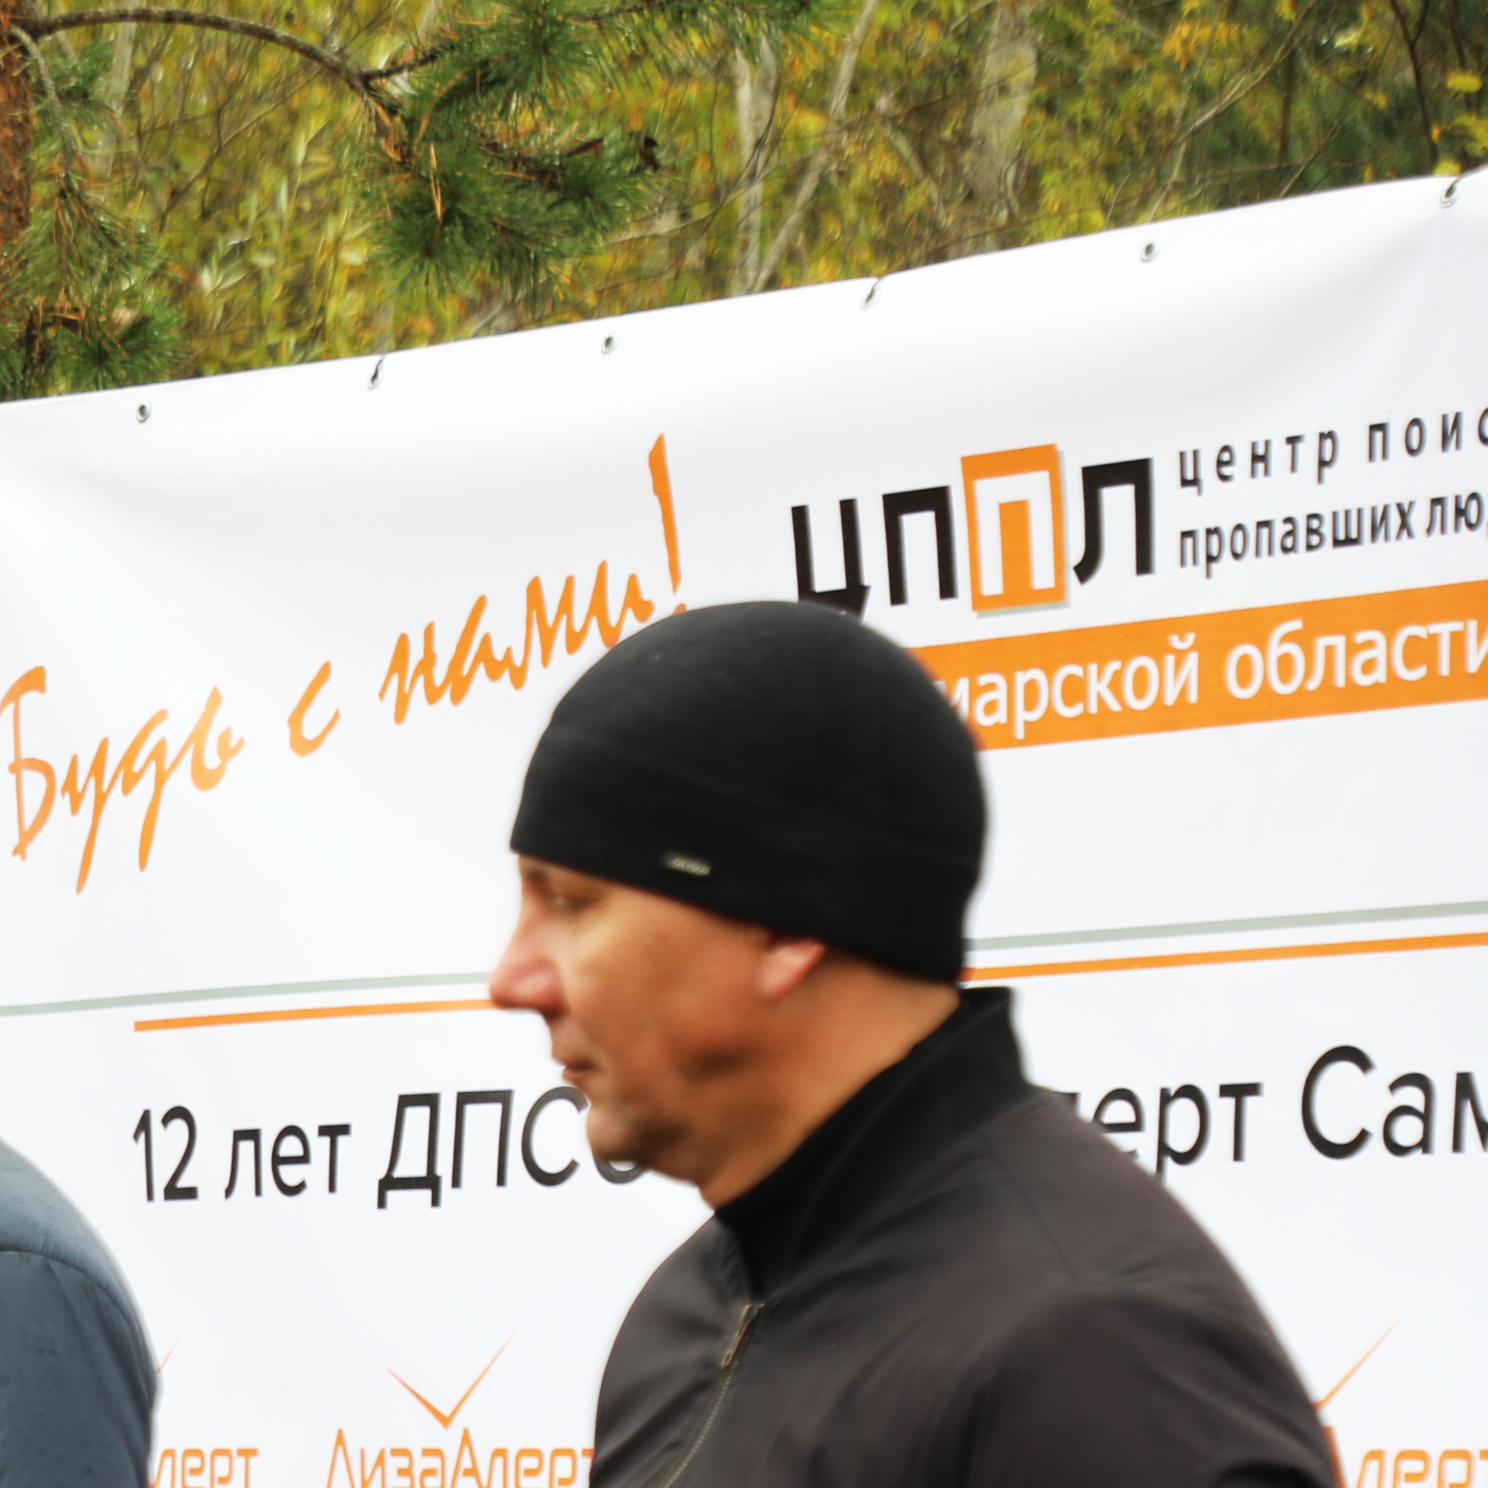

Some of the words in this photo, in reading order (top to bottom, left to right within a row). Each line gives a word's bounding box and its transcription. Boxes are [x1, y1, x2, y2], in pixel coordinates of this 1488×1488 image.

[1179, 428, 1340, 496] центр
[1179, 499, 1417, 580] пропавших
[1425, 491, 1488, 548] лю
[0, 664, 246, 895] Будь
[287, 660, 342, 757] с
[378, 432, 689, 725] нами!
[132, 1104, 199, 1203] 12
[224, 1123, 352, 1201] лет
[1054, 1081, 1264, 1180] ерт
